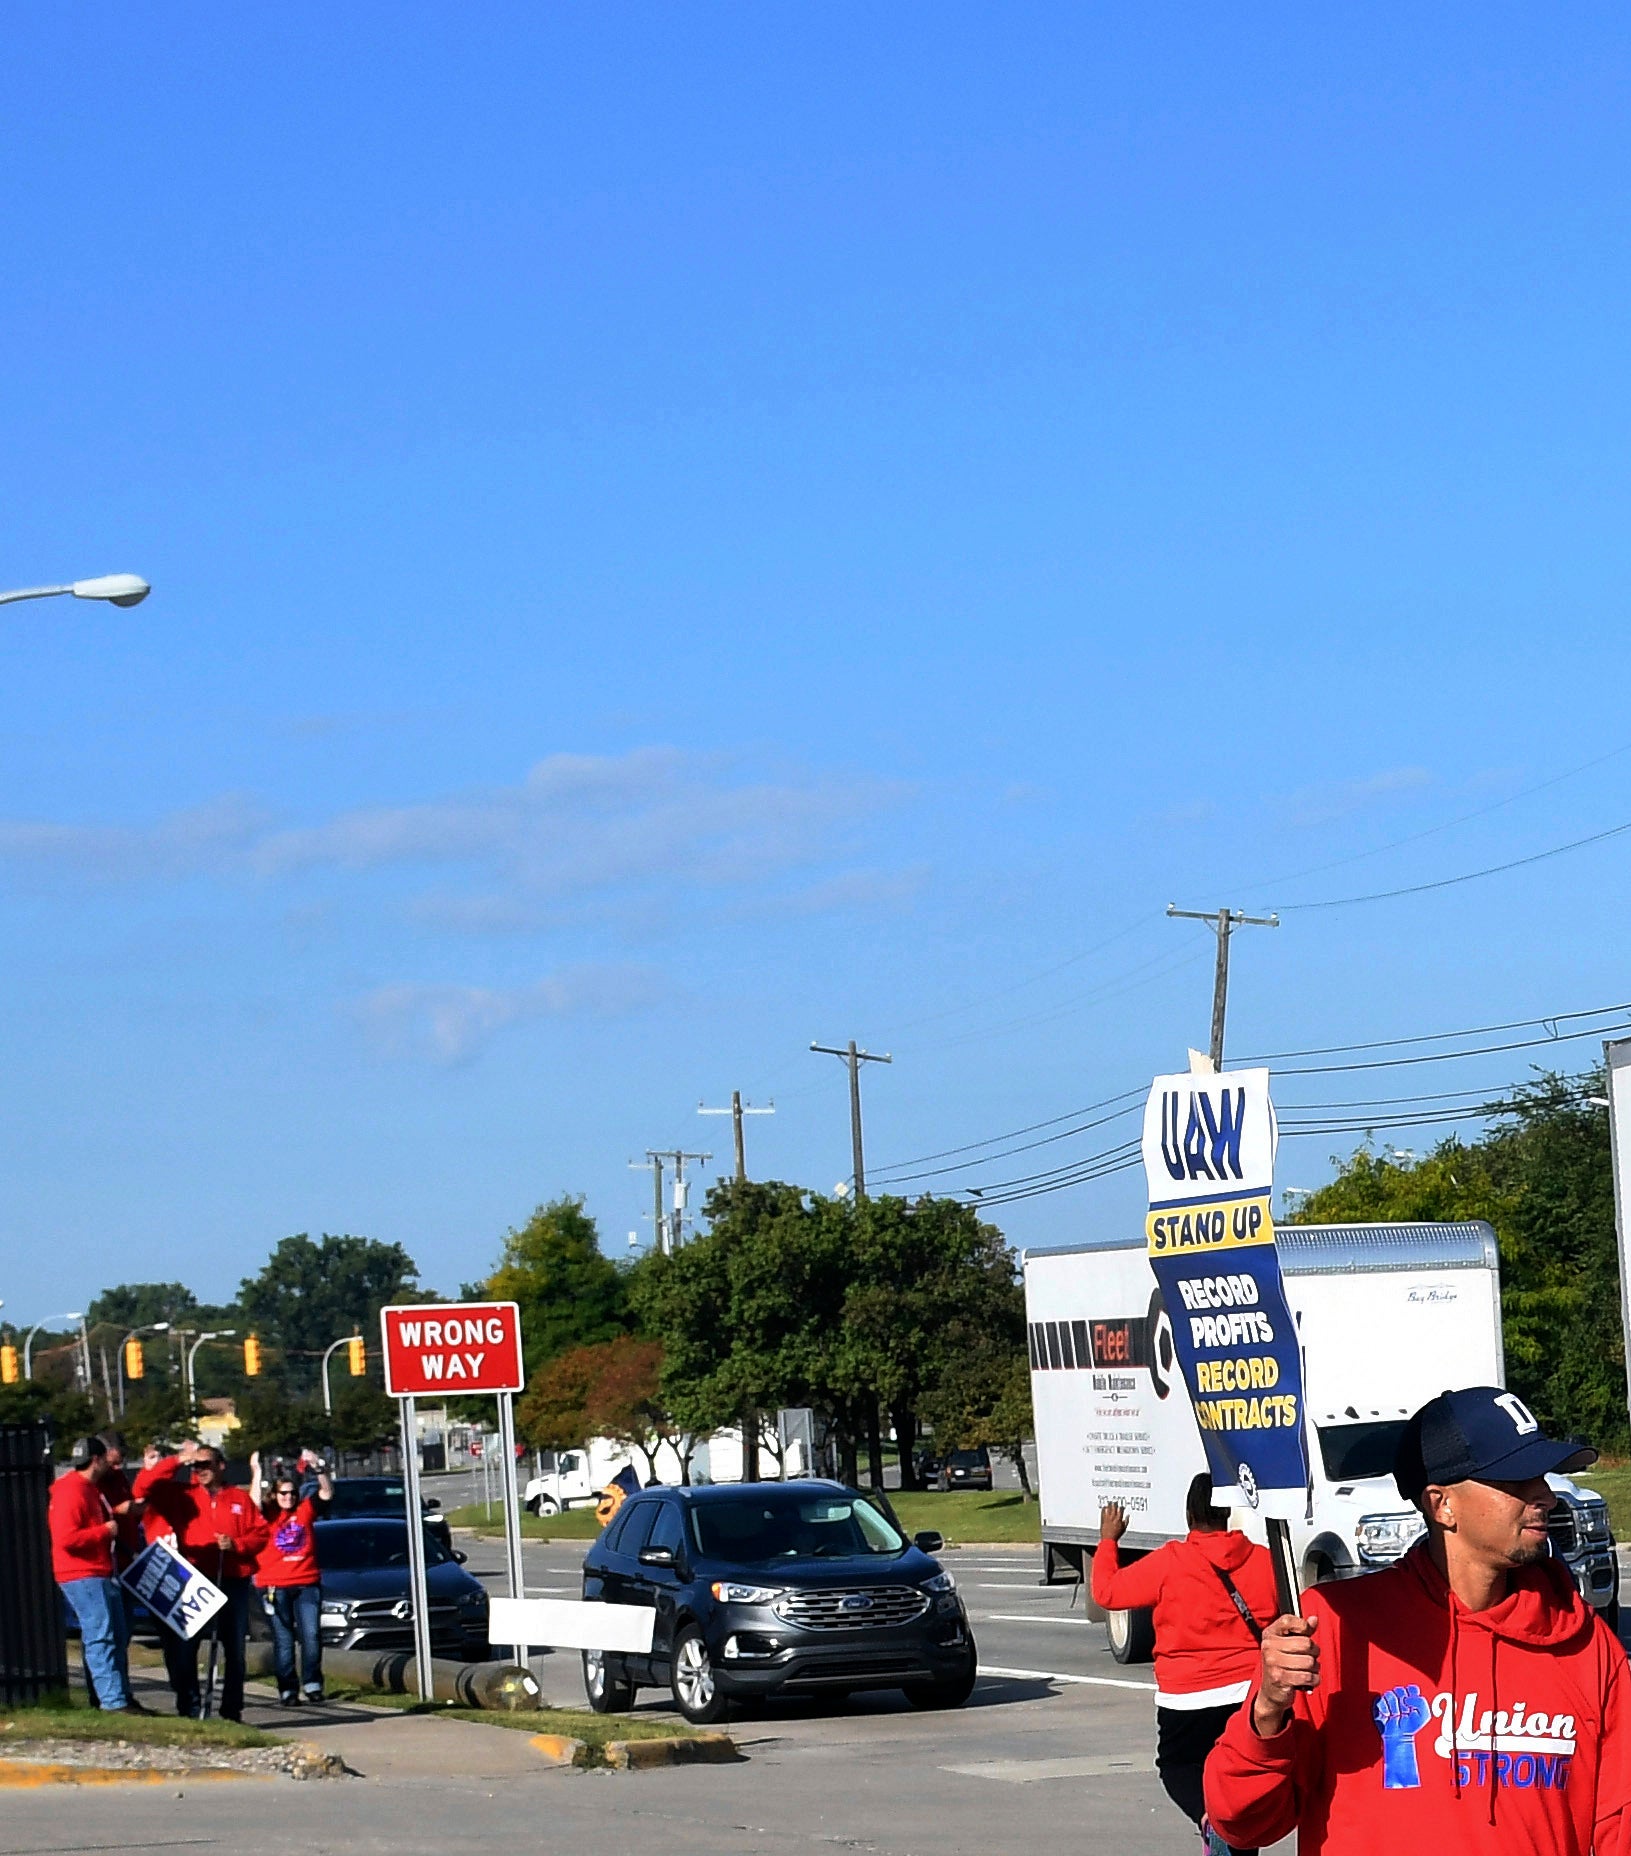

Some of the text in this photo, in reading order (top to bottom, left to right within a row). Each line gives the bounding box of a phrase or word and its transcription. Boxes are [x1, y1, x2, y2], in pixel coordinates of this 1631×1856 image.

[1160, 1086, 1246, 1181] UAW
[1153, 1204, 1262, 1250] STAND UP
[1177, 1273, 1260, 1311] RECORD
[398, 1317, 505, 1348] WRONG
[1094, 1323, 1130, 1361] Fleet
[1189, 1311, 1275, 1349] PROFITS
[420, 1351, 485, 1381] WAY
[1195, 1356, 1280, 1393] RECORD
[1493, 1392, 1539, 1436] D
[135, 1546, 172, 1600] STRIKE
[158, 1573, 181, 1602] ON
[171, 1585, 216, 1631] UAW
[1431, 1691, 1577, 1742] Union
[1451, 1751, 1572, 1790] STRONG
